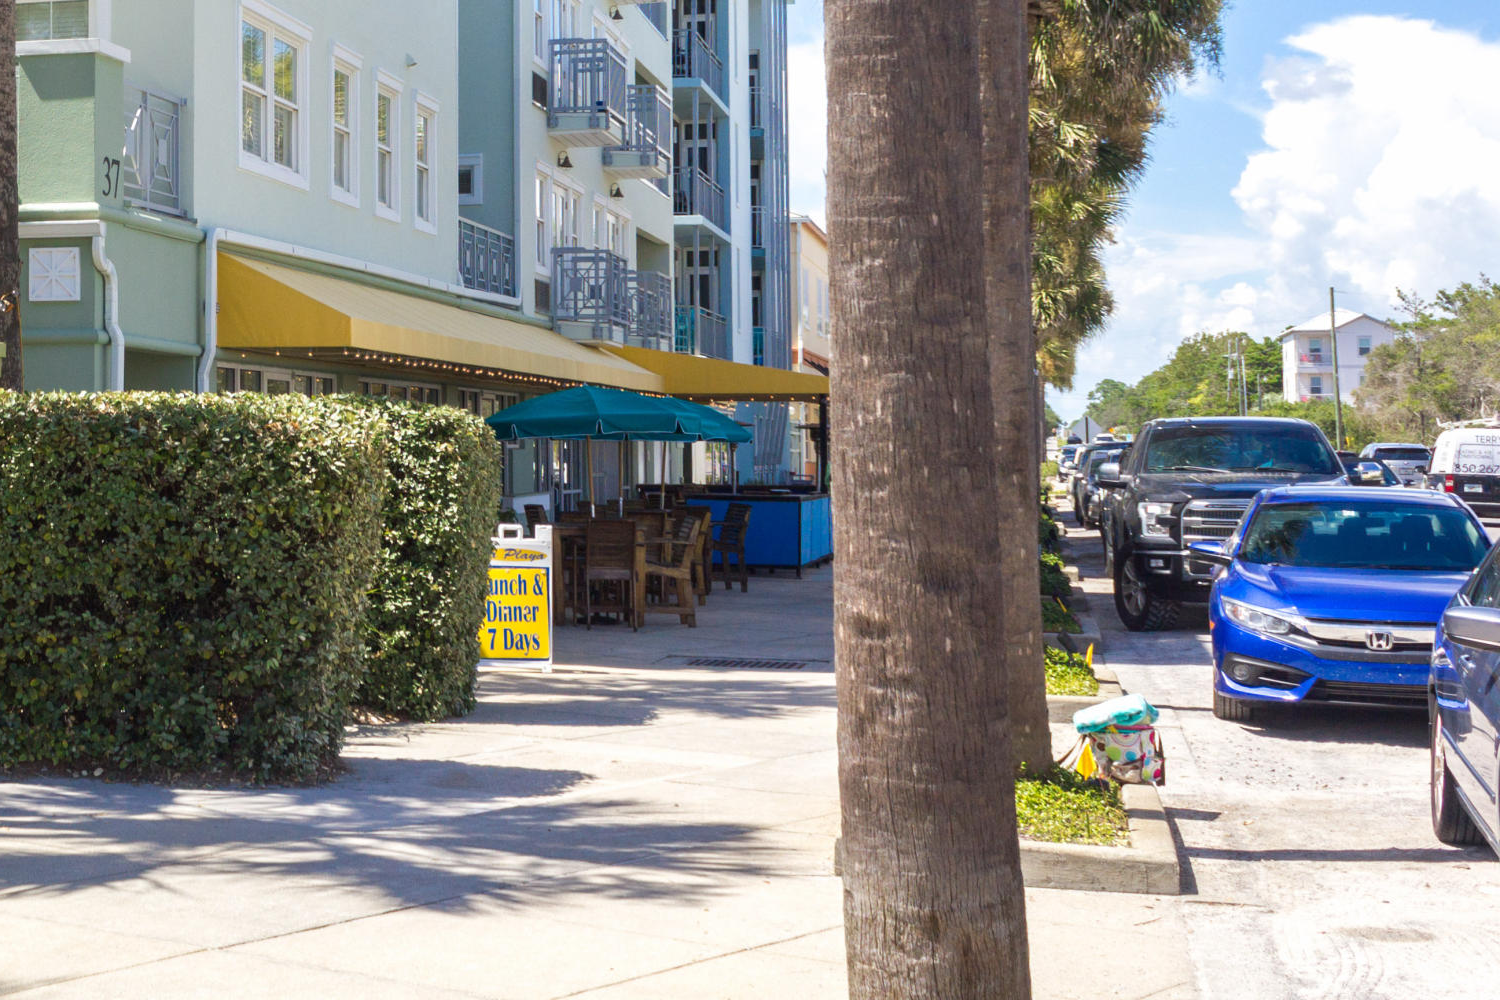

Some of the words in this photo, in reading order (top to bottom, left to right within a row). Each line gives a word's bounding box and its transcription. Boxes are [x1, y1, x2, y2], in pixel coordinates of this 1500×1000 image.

[102, 156, 121, 199] 37
[1475, 435, 1500, 444] TERR
[504, 548, 545, 562] Playa
[488, 573, 528, 596] unch
[533, 573, 544, 596] &
[486, 600, 540, 623] Dinner
[487, 628, 497, 651] 7
[503, 628, 541, 656] Days
